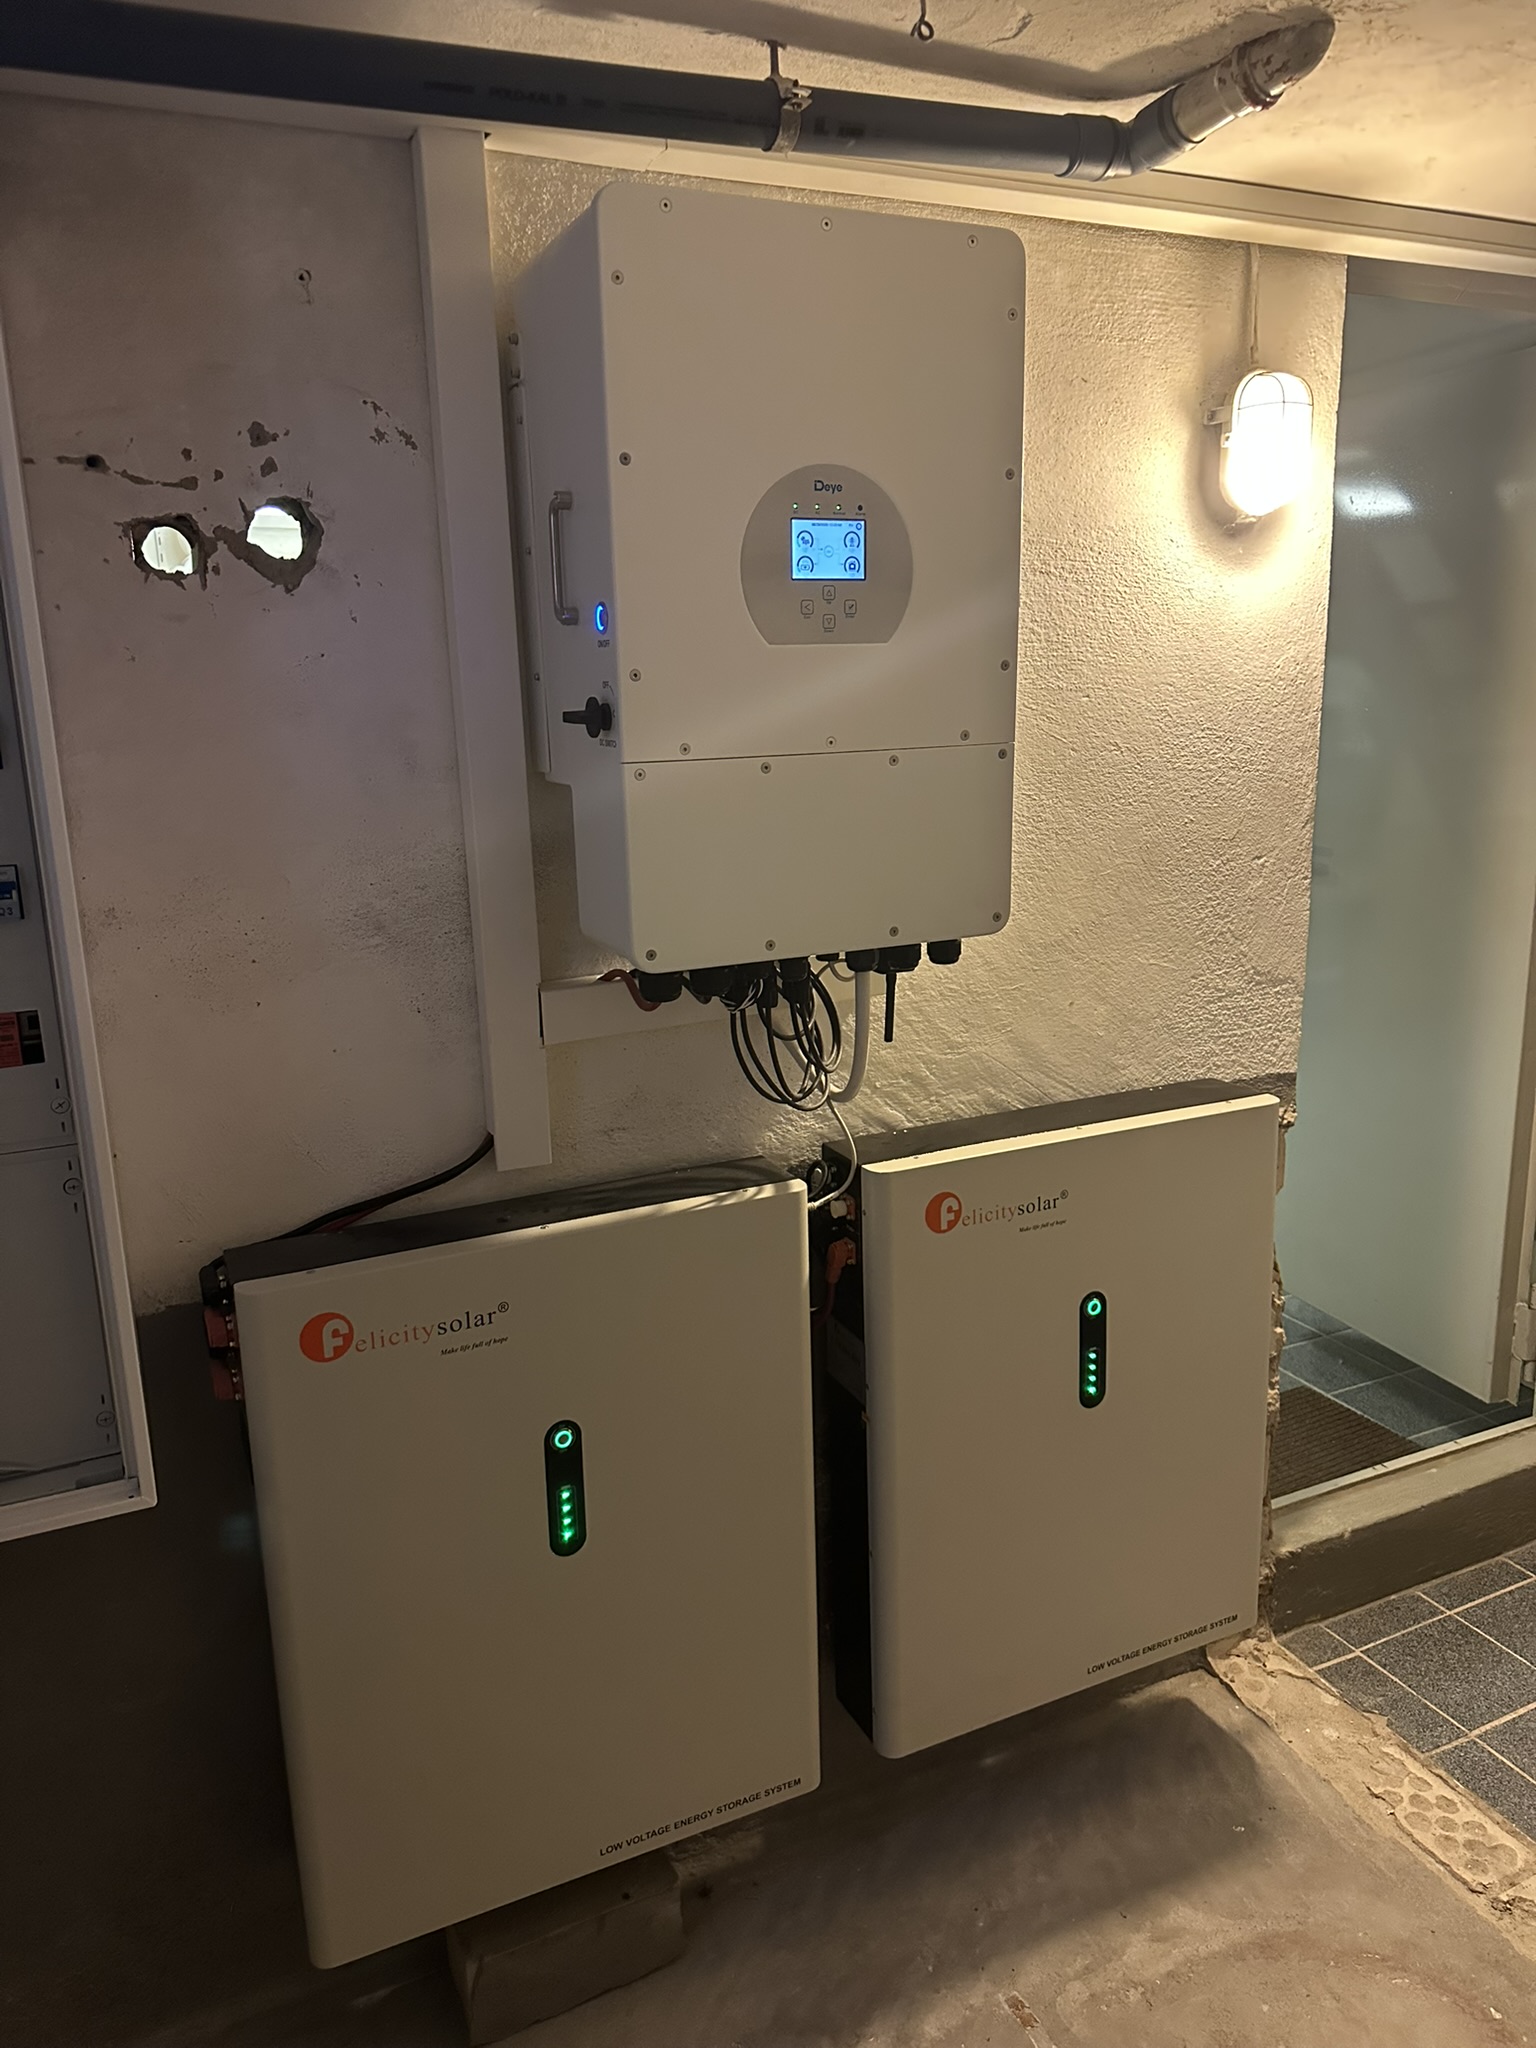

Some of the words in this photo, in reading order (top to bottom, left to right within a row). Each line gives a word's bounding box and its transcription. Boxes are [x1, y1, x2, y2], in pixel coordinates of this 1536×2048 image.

[814, 480, 843, 494] Deye
[440, 1347, 460, 1356] Make
[459, 1344, 471, 1352] life
[471, 1341, 483, 1350] full
[484, 1338, 493, 1347] of
[493, 1336, 509, 1345] hope
[1087, 1662, 1106, 1675] LOW
[1106, 1649, 1141, 1668] VOLTAGE
[1142, 1637, 1173, 1655] ENERGY
[1173, 1624, 1208, 1643] STORAGE
[1209, 1613, 1239, 1630] SYSTEM
[600, 1841, 624, 1857] LOW
[626, 1824, 671, 1847] VOLTAGE
[673, 1808, 714, 1830] ENERGY
[716, 1792, 762, 1815] STORAGE
[764, 1777, 801, 1797] SYSTEM
